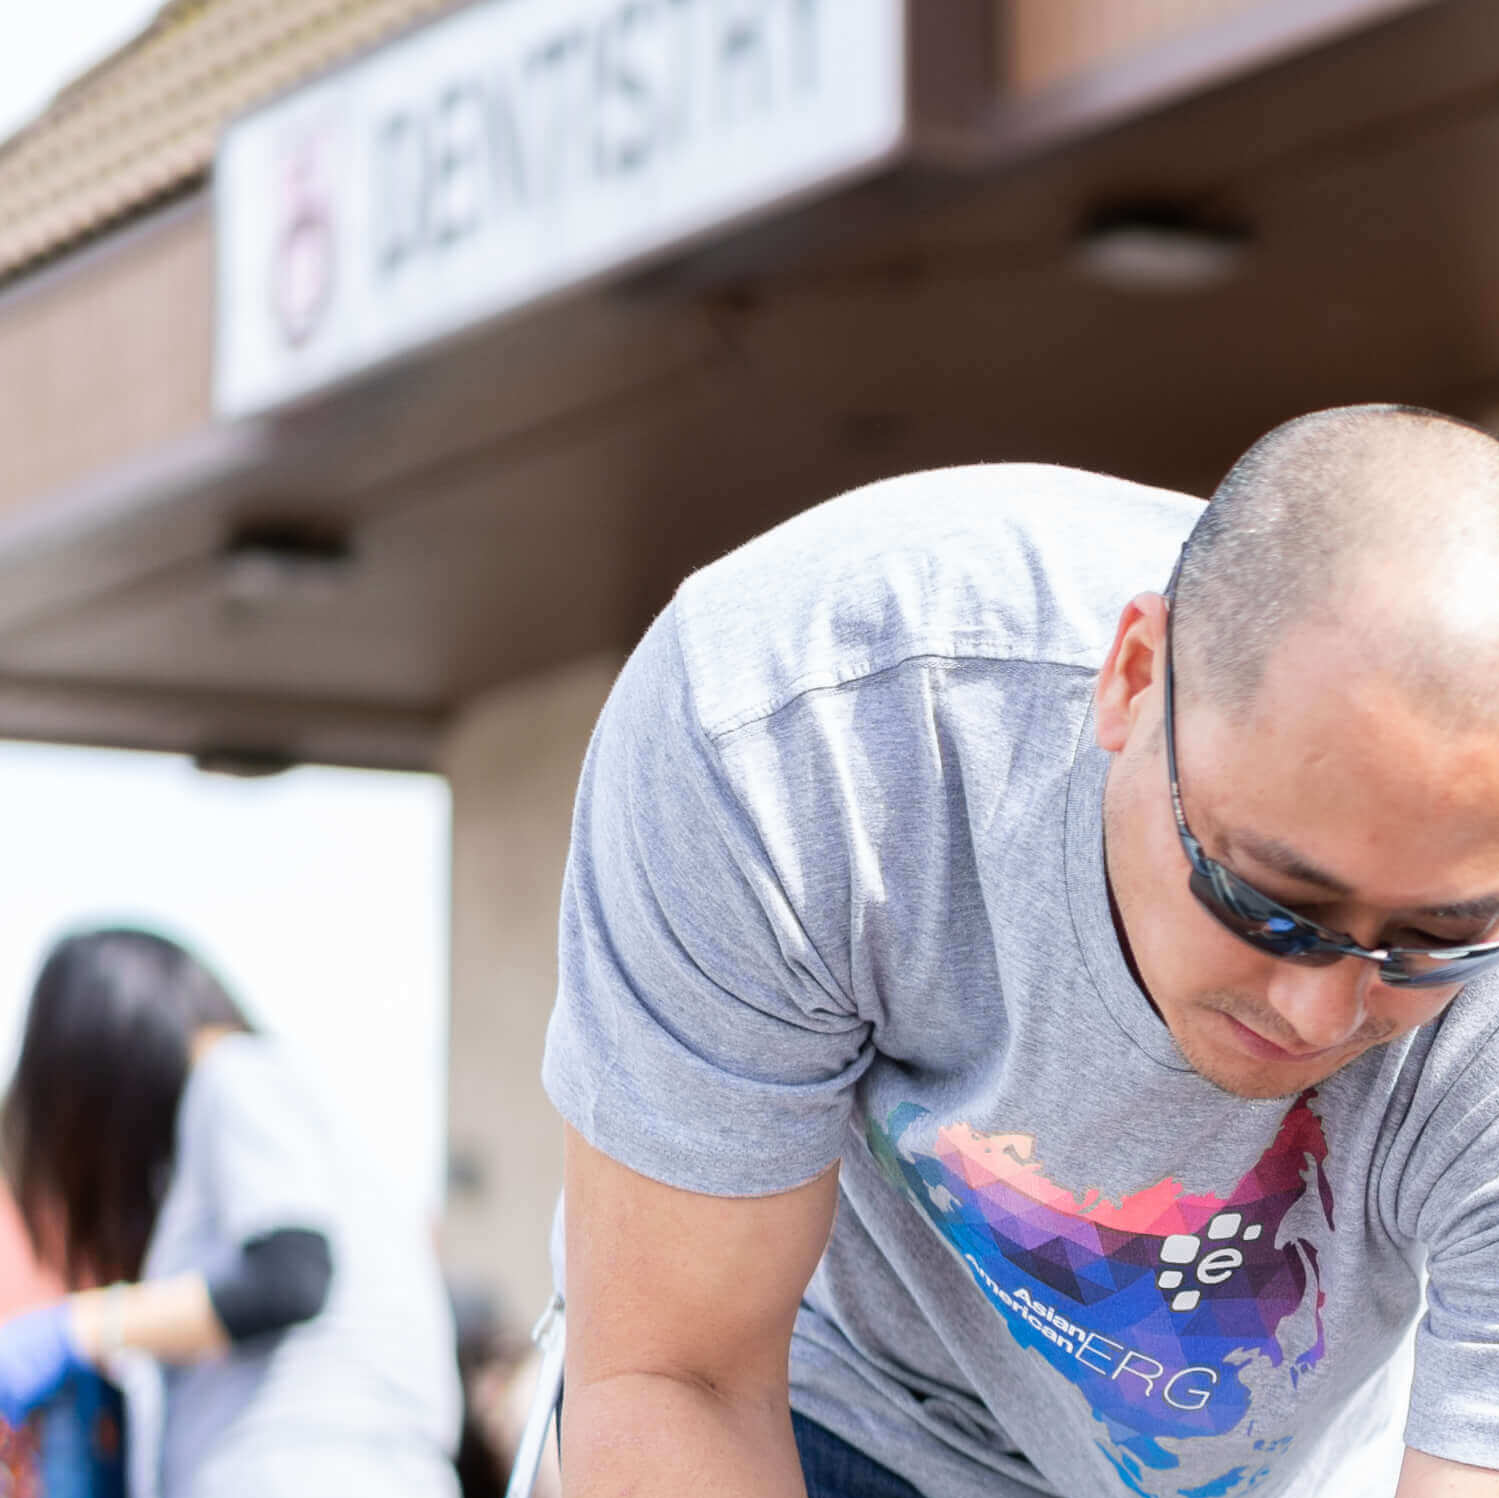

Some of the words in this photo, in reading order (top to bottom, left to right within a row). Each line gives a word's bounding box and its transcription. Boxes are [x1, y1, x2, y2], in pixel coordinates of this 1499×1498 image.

[1195, 1247, 1244, 1285] e
[964, 1252, 1075, 1355] American
[1012, 1287, 1087, 1343] Asian
[1074, 1332, 1219, 1411] ERG
